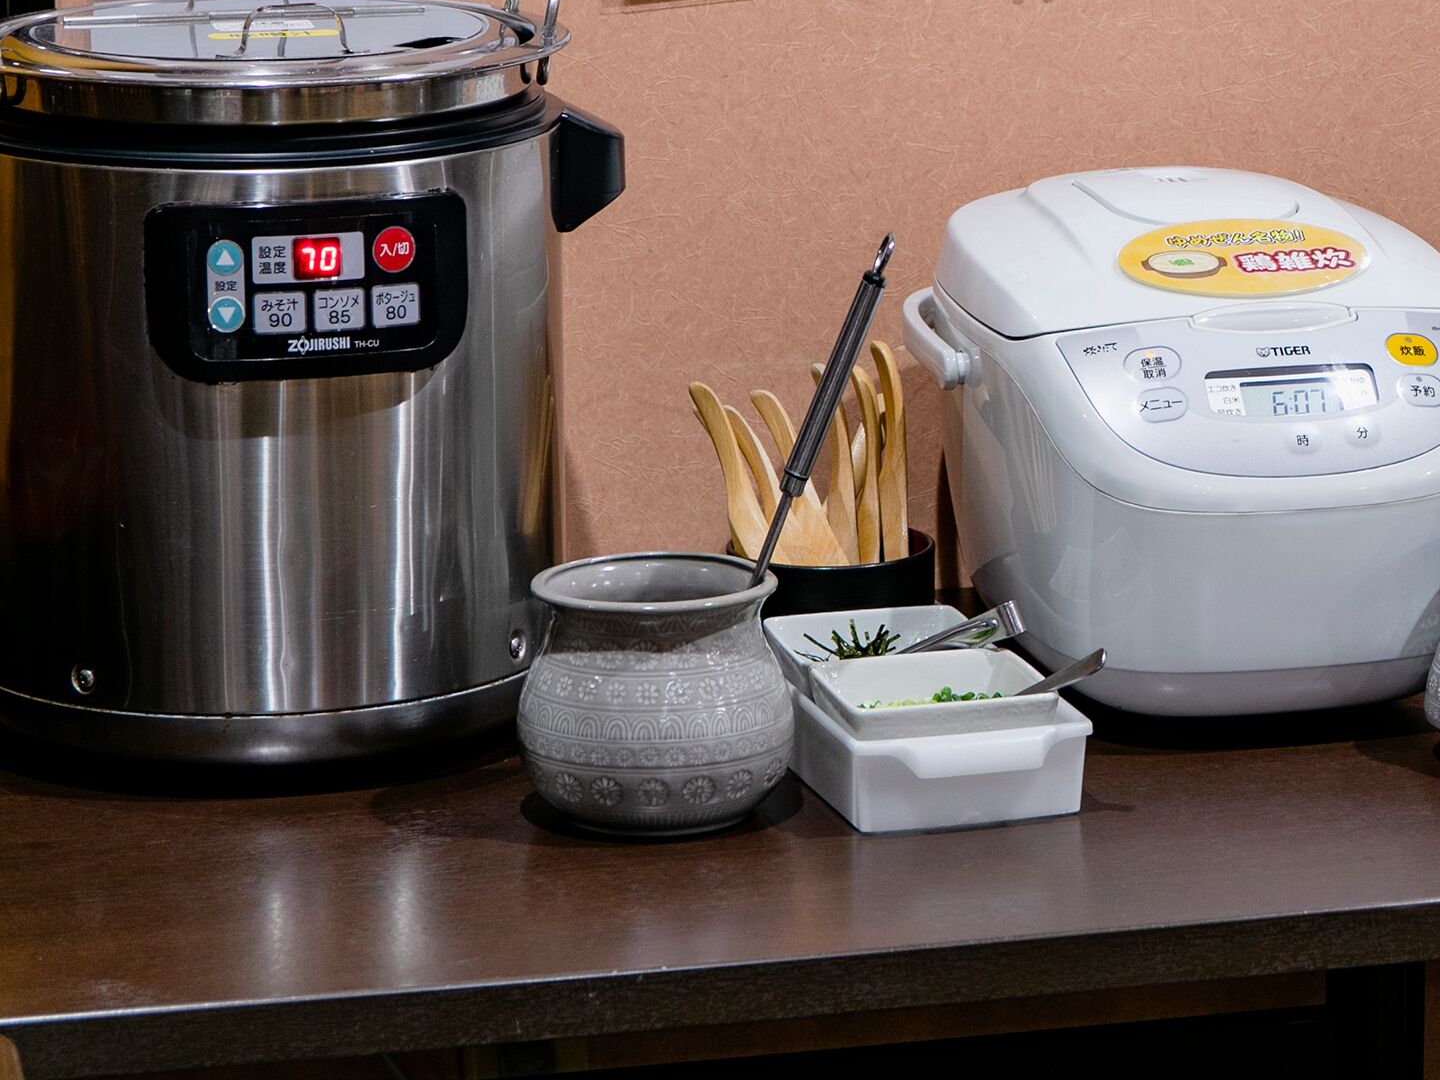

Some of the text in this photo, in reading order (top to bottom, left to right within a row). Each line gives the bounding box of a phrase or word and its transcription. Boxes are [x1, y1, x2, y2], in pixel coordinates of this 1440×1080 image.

[258, 245, 287, 259] 設定
[379, 241, 411, 258] 入/切
[301, 246, 338, 272] 70
[1235, 247, 1355, 274] 鶏雑炊
[258, 261, 287, 275] 温度
[214, 280, 238, 292] 設定
[260, 298, 299, 313] みそ汁
[318, 294, 361, 309] コンソメ
[268, 312, 293, 328] 90
[328, 309, 351, 324] 85
[385, 305, 407, 320] 80
[287, 336, 380, 355] ZOJIRUSHI TH-CU
[1270, 345, 1312, 357] TIGER
[1399, 344, 1426, 357] 炊飯
[1140, 356, 1165, 367] 保温
[1142, 367, 1168, 379] 取消
[1410, 384, 1437, 398] 予約
[1138, 398, 1184, 413] メニュー
[1271, 388, 1328, 417] 6:07
[1296, 433, 1310, 447] 時
[1356, 426, 1369, 439] 分
